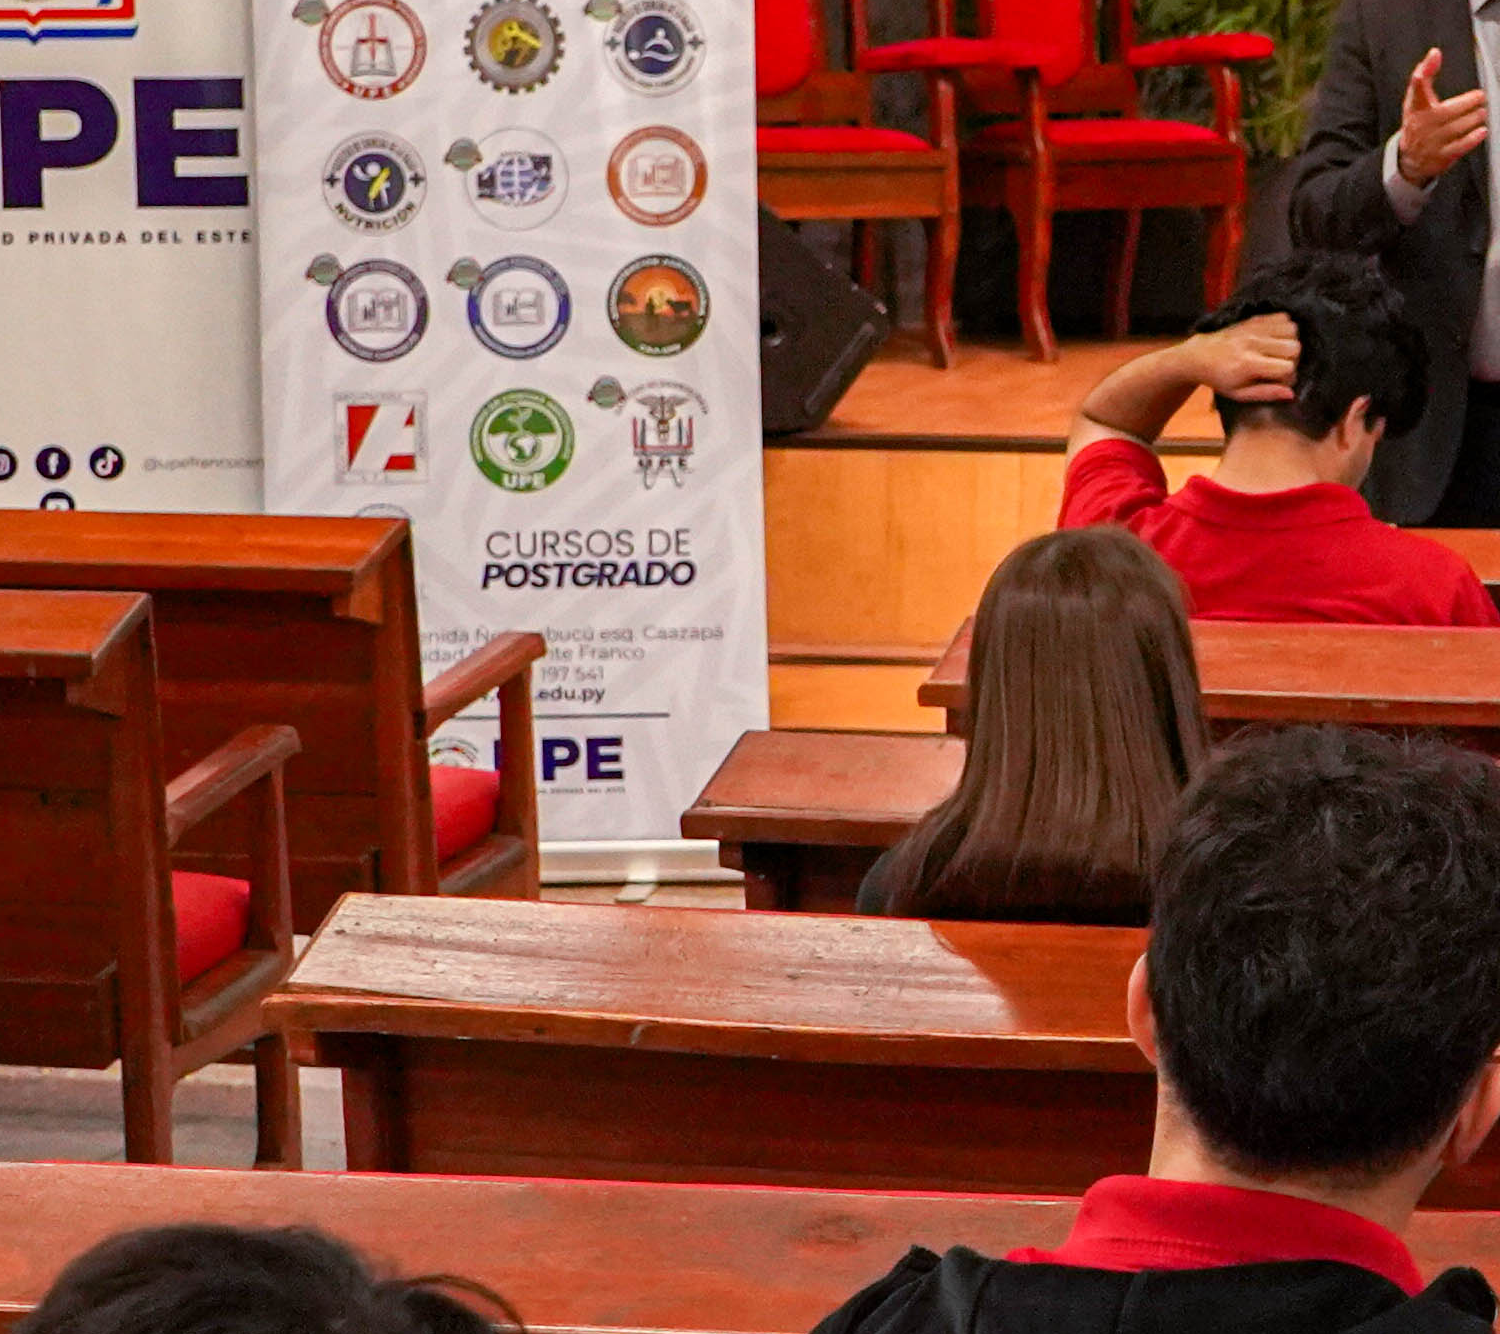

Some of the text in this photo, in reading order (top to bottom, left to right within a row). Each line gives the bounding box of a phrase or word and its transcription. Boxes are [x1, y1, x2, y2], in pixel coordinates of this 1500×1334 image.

[28, 230, 127, 246] PRIVADA
[141, 230, 183, 245] DEL
[196, 229, 253, 244] ESTE
[485, 528, 693, 559] CURSOS DE
[481, 559, 697, 590] POSTGRADO
[578, 646, 645, 661] Franco
[494, 736, 624, 780] PE
